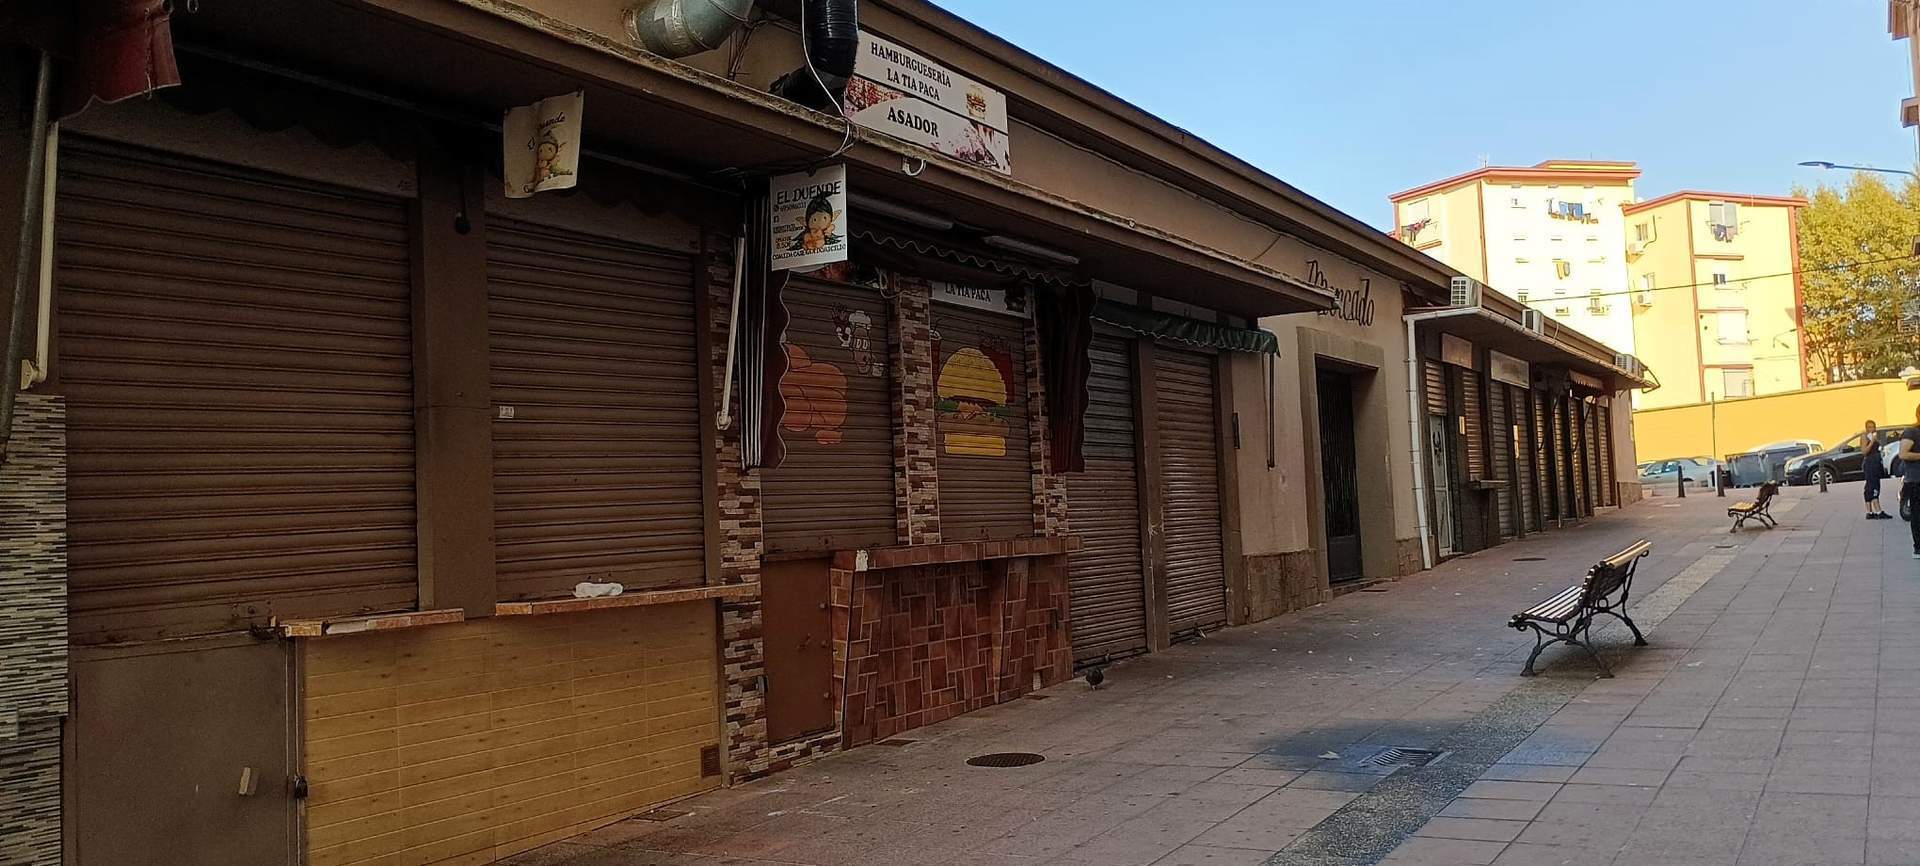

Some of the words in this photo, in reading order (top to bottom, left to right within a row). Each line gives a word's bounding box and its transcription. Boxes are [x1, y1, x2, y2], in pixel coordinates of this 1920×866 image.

[871, 42, 952, 88] HAMBURGUESERÍA
[887, 68, 900, 85] LA
[901, 74, 917, 92] TIA
[918, 80, 940, 101] PACA
[887, 106, 939, 138] ASADOR
[777, 190, 790, 205] EL
[792, 180, 842, 202] DUENDE
[945, 281, 955, 295] LA
[957, 284, 970, 298] TIA
[971, 288, 991, 302] PACA
